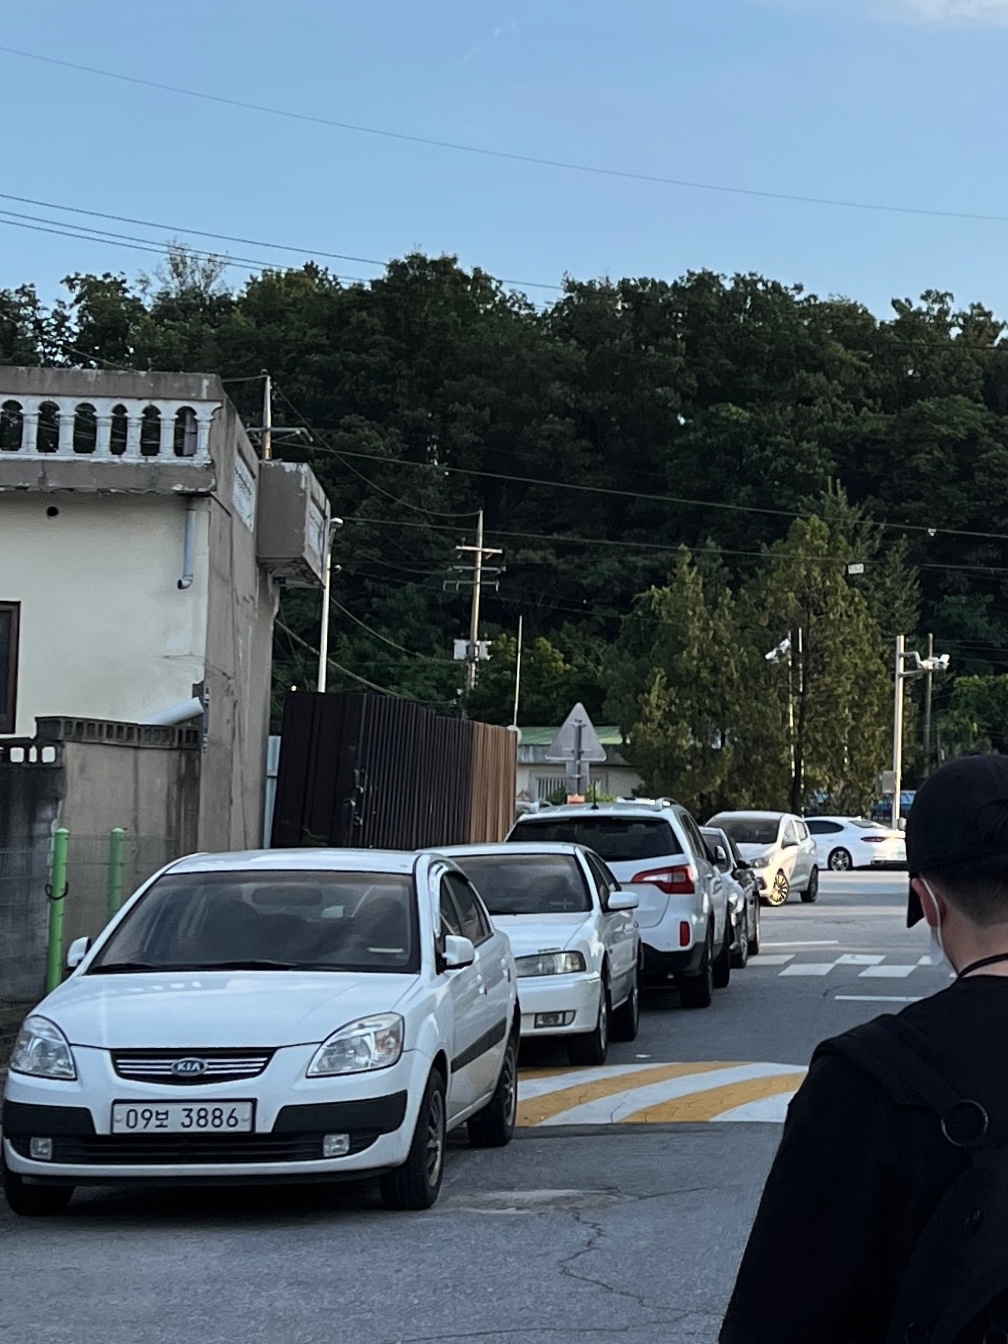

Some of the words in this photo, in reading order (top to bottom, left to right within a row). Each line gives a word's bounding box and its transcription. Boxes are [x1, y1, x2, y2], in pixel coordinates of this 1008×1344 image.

[176, 1061, 201, 1073] KIA
[125, 1108, 169, 1129] 09보
[180, 1107, 239, 1129] 3886
